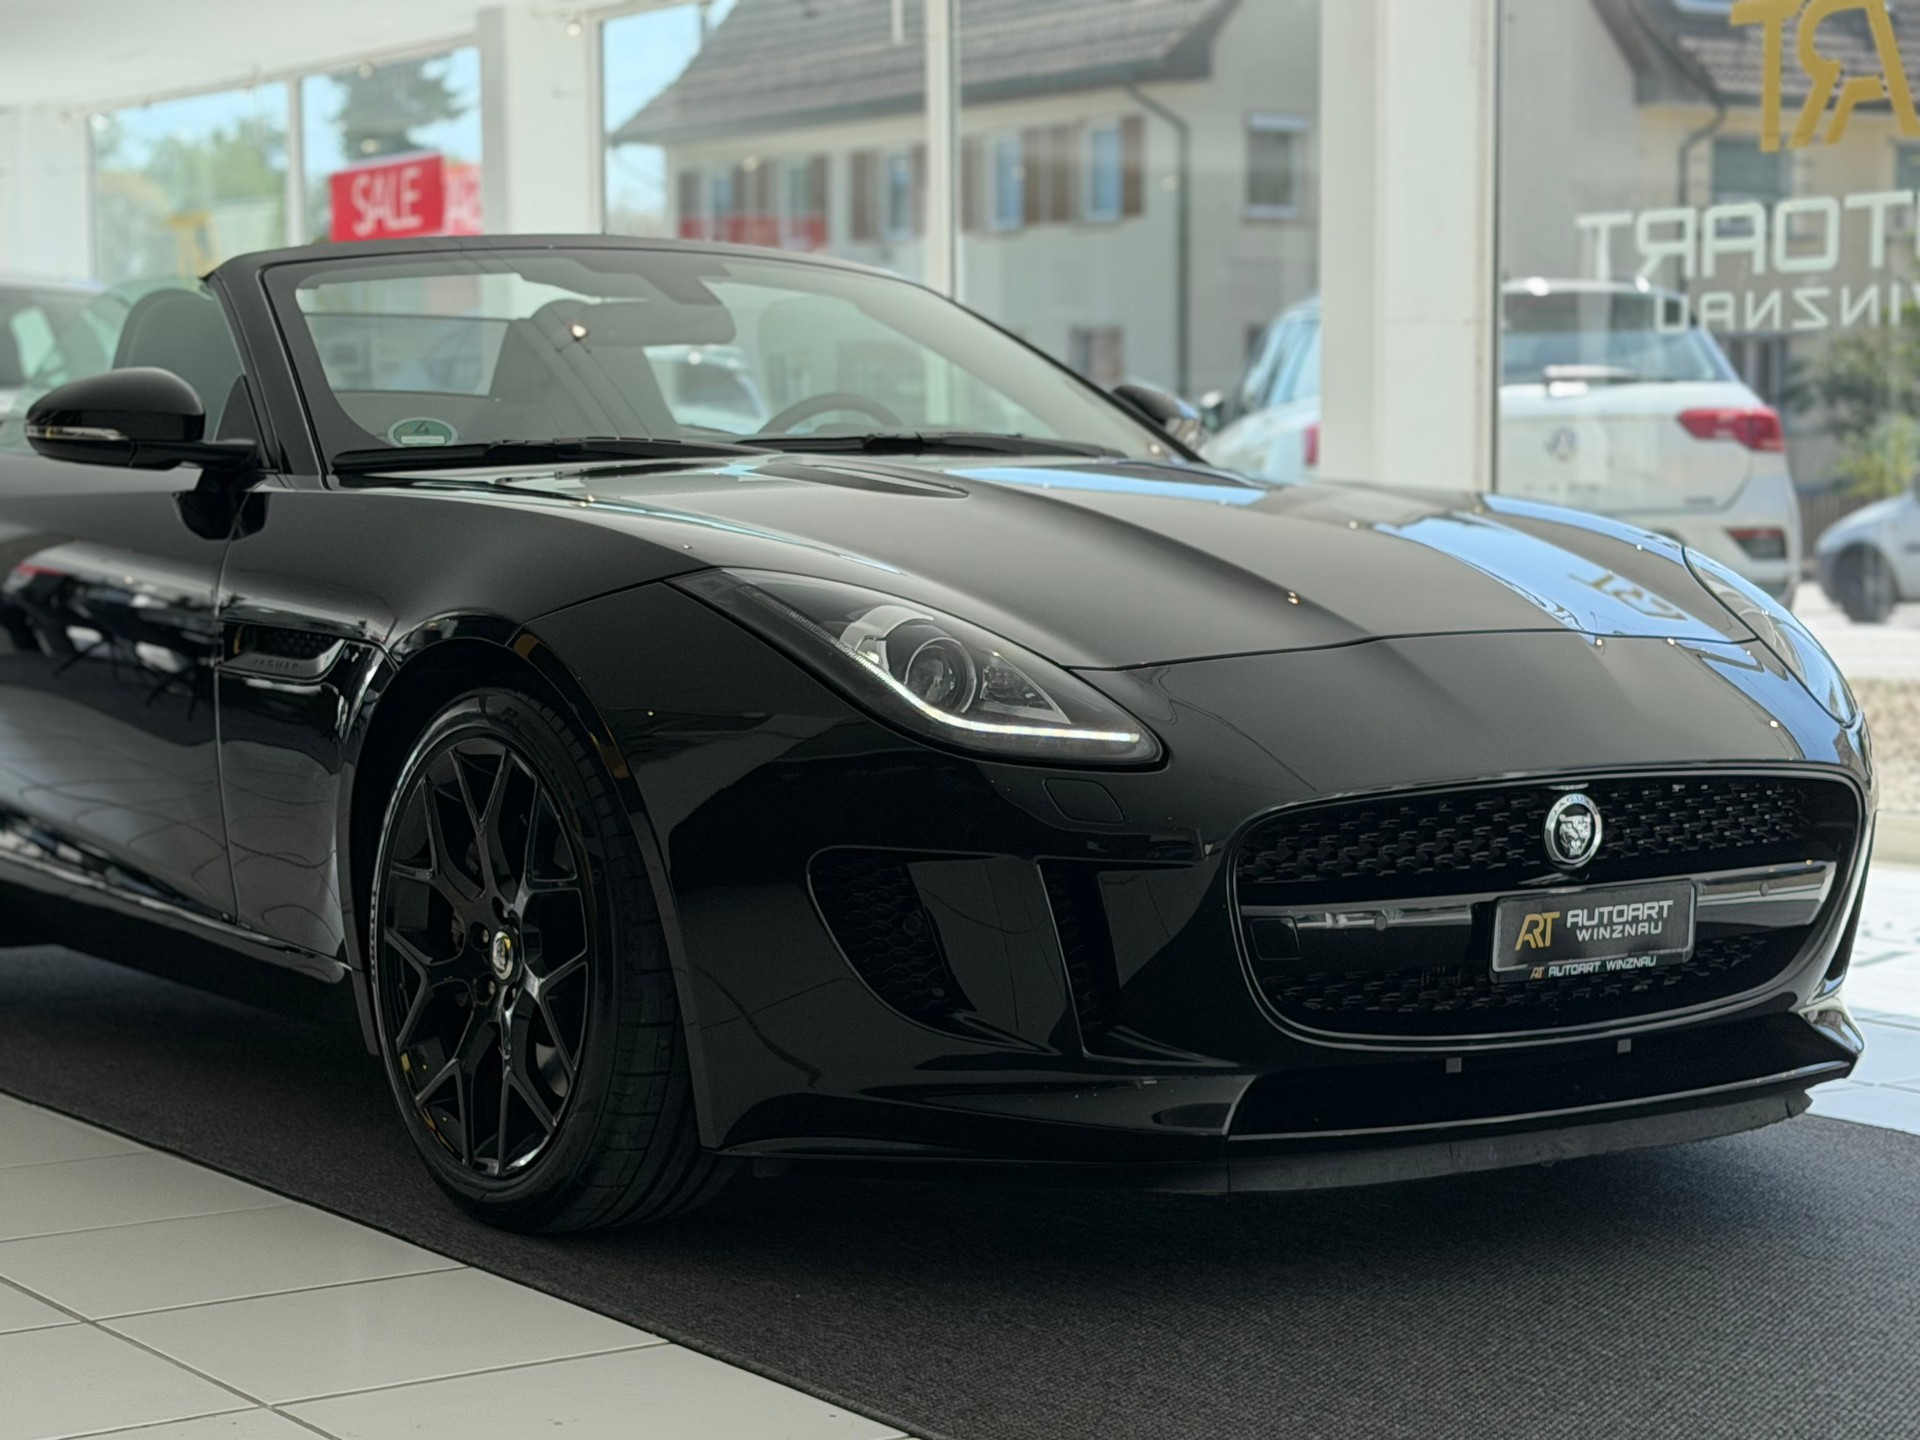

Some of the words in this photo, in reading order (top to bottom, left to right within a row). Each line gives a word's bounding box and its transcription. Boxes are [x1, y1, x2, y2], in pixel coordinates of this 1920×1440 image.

[351, 166, 425, 238] SALE
[1566, 900, 1674, 928] AUTOART
[1576, 921, 1662, 942] WINZNAU
[1548, 960, 1602, 978] AUTOART
[1606, 955, 1657, 972] WINZNAU
